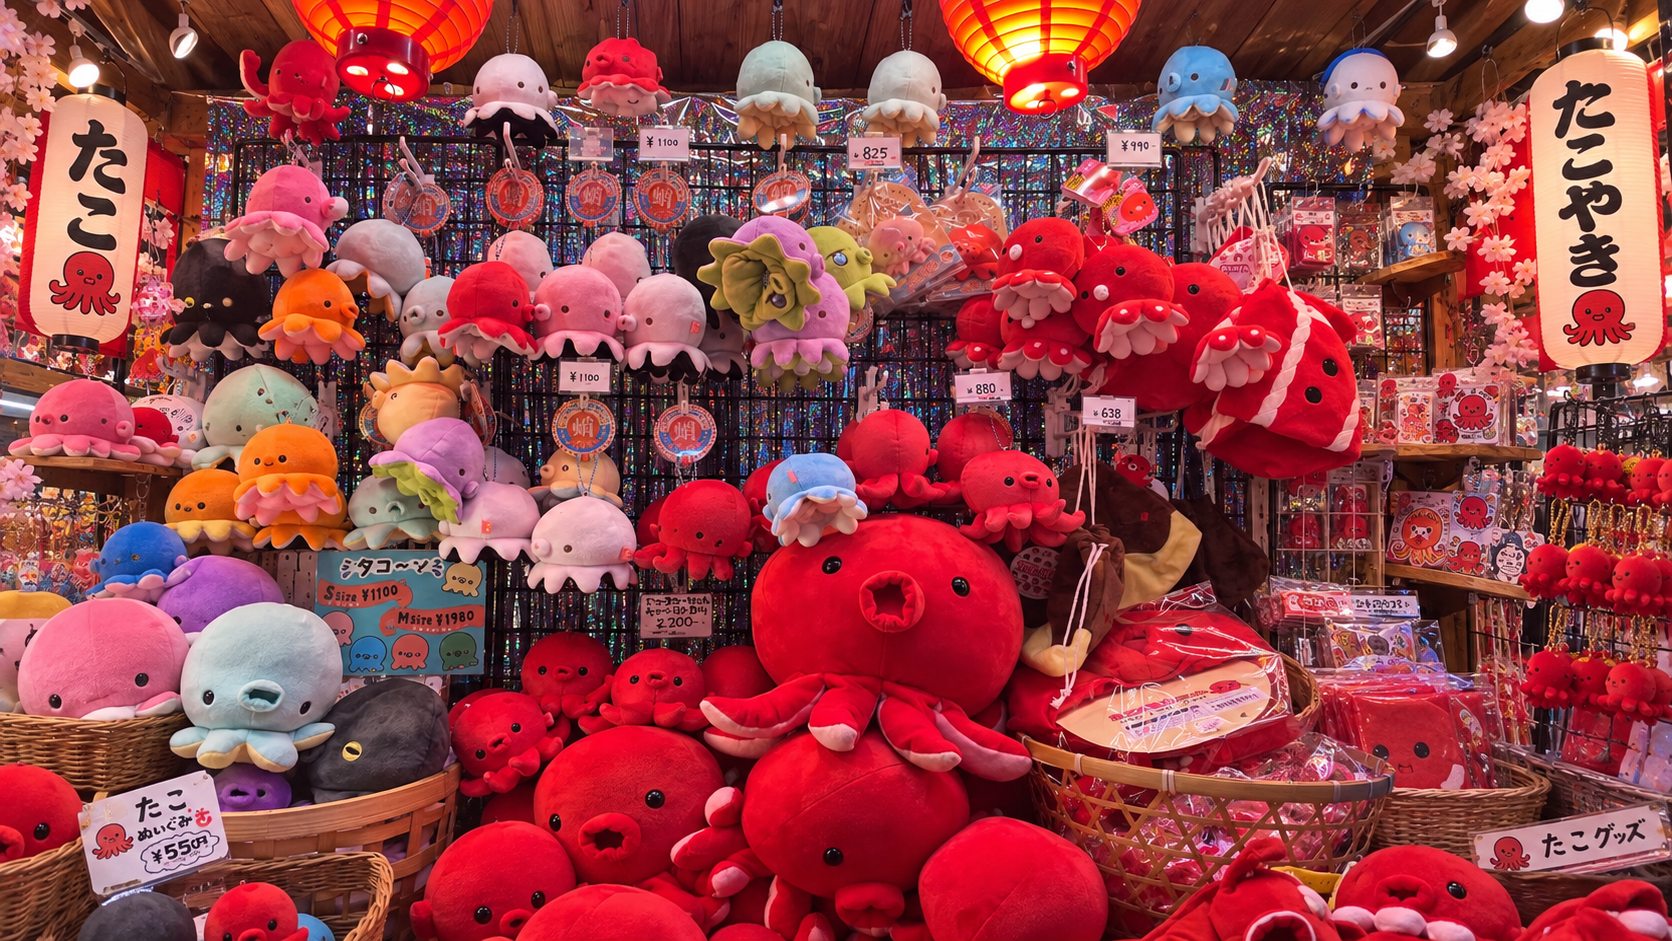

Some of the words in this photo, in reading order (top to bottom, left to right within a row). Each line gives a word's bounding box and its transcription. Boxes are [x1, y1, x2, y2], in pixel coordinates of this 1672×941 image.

[67, 119, 128, 251] たこ
[1552, 80, 1623, 287] たこやき
[362, 584, 398, 602] ¥1100
[435, 610, 475, 626] ¥1980
[135, 789, 187, 823] たこ
[1541, 818, 1646, 858] たこグッズ
